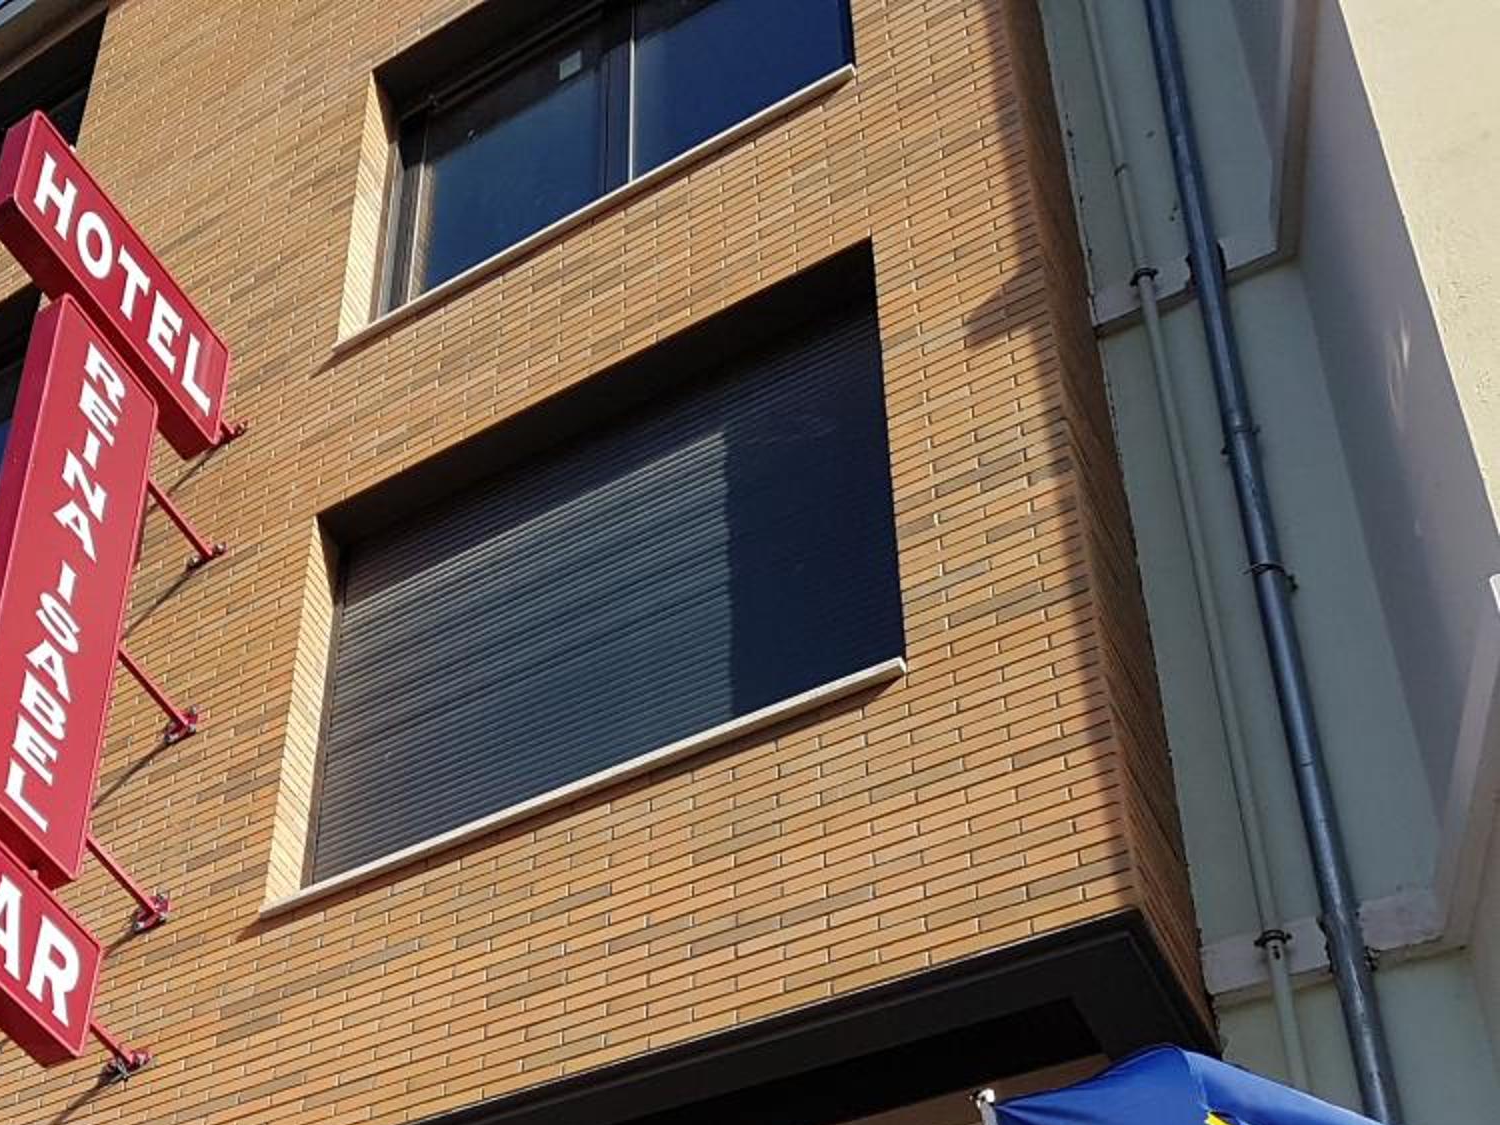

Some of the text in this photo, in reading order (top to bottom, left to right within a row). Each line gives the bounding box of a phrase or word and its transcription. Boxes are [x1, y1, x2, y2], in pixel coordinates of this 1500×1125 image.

[34, 152, 211, 416] HOTEL
[5, 342, 126, 832] REINA ISABEL
